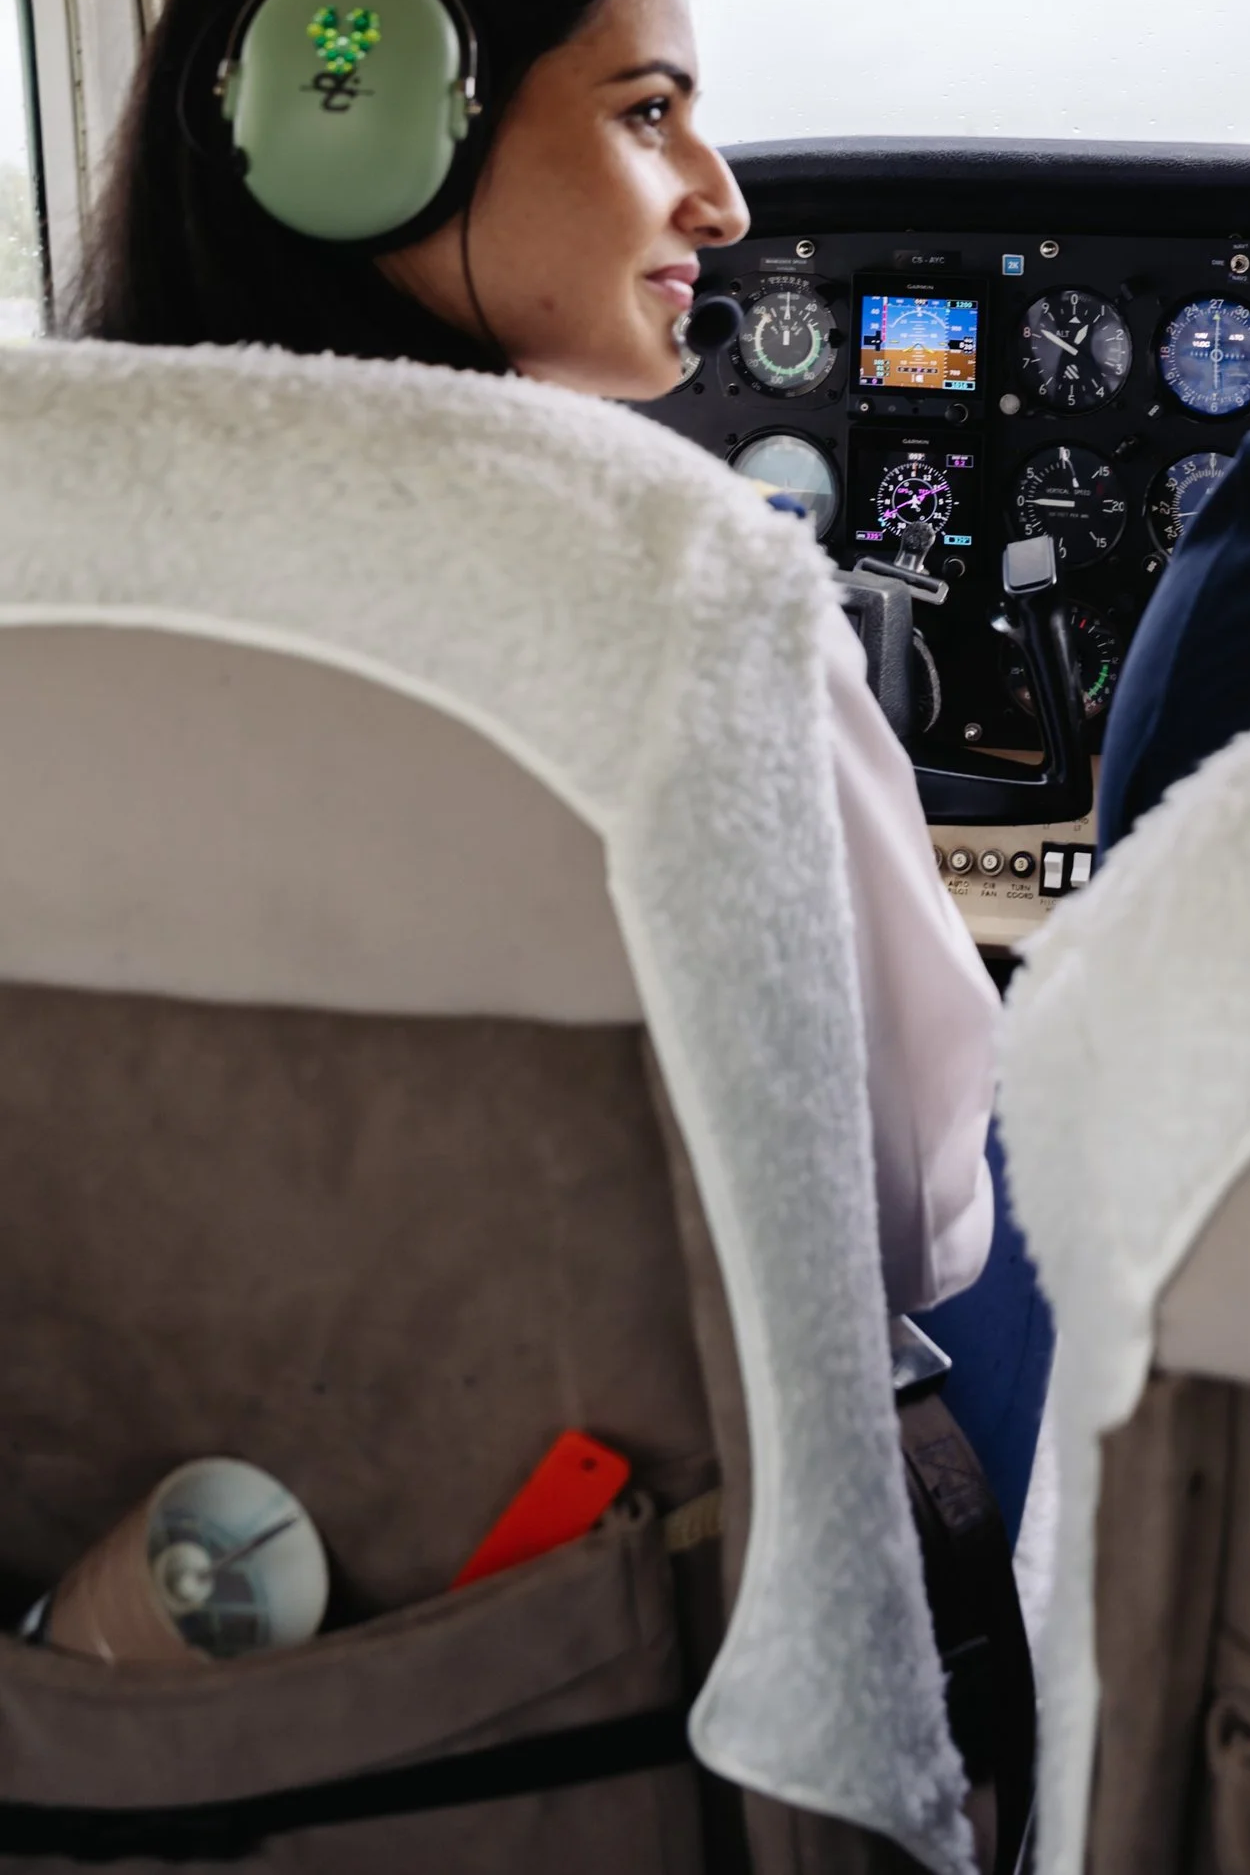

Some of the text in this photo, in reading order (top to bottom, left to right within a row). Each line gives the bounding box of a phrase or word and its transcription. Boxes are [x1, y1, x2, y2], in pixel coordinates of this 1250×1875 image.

[1070, 294, 1078, 305] 0
[1210, 299, 1224, 309] 27
[805, 303, 817, 312] 40
[1042, 303, 1049, 314] 9
[1184, 303, 1199, 317] 24
[1235, 305, 1250, 319] 30
[1023, 327, 1031, 338] 8
[1166, 321, 1180, 335] 21
[1056, 330, 1070, 338] ALT
[1115, 329, 1124, 340] 2
[1160, 345, 1170, 359] 18
[1022, 357, 1031, 369] 7
[1115, 364, 1124, 375] 3
[1039, 384, 1047, 395] 6
[1096, 387, 1104, 398] 4
[1068, 395, 1076, 406] 5
[1180, 391, 1195, 405] 12
[1026, 467, 1035, 478] 5
[1099, 466, 1110, 477] 15
[1182, 461, 1196, 475] 33
[1165, 478, 1178, 491] 30
[1016, 496, 1025, 506] 0
[1112, 501, 1125, 512] 20
[1160, 501, 1170, 515] 27
[1025, 524, 1033, 535] 5
[1163, 525, 1178, 540] 24
[1096, 538, 1107, 548] 15
